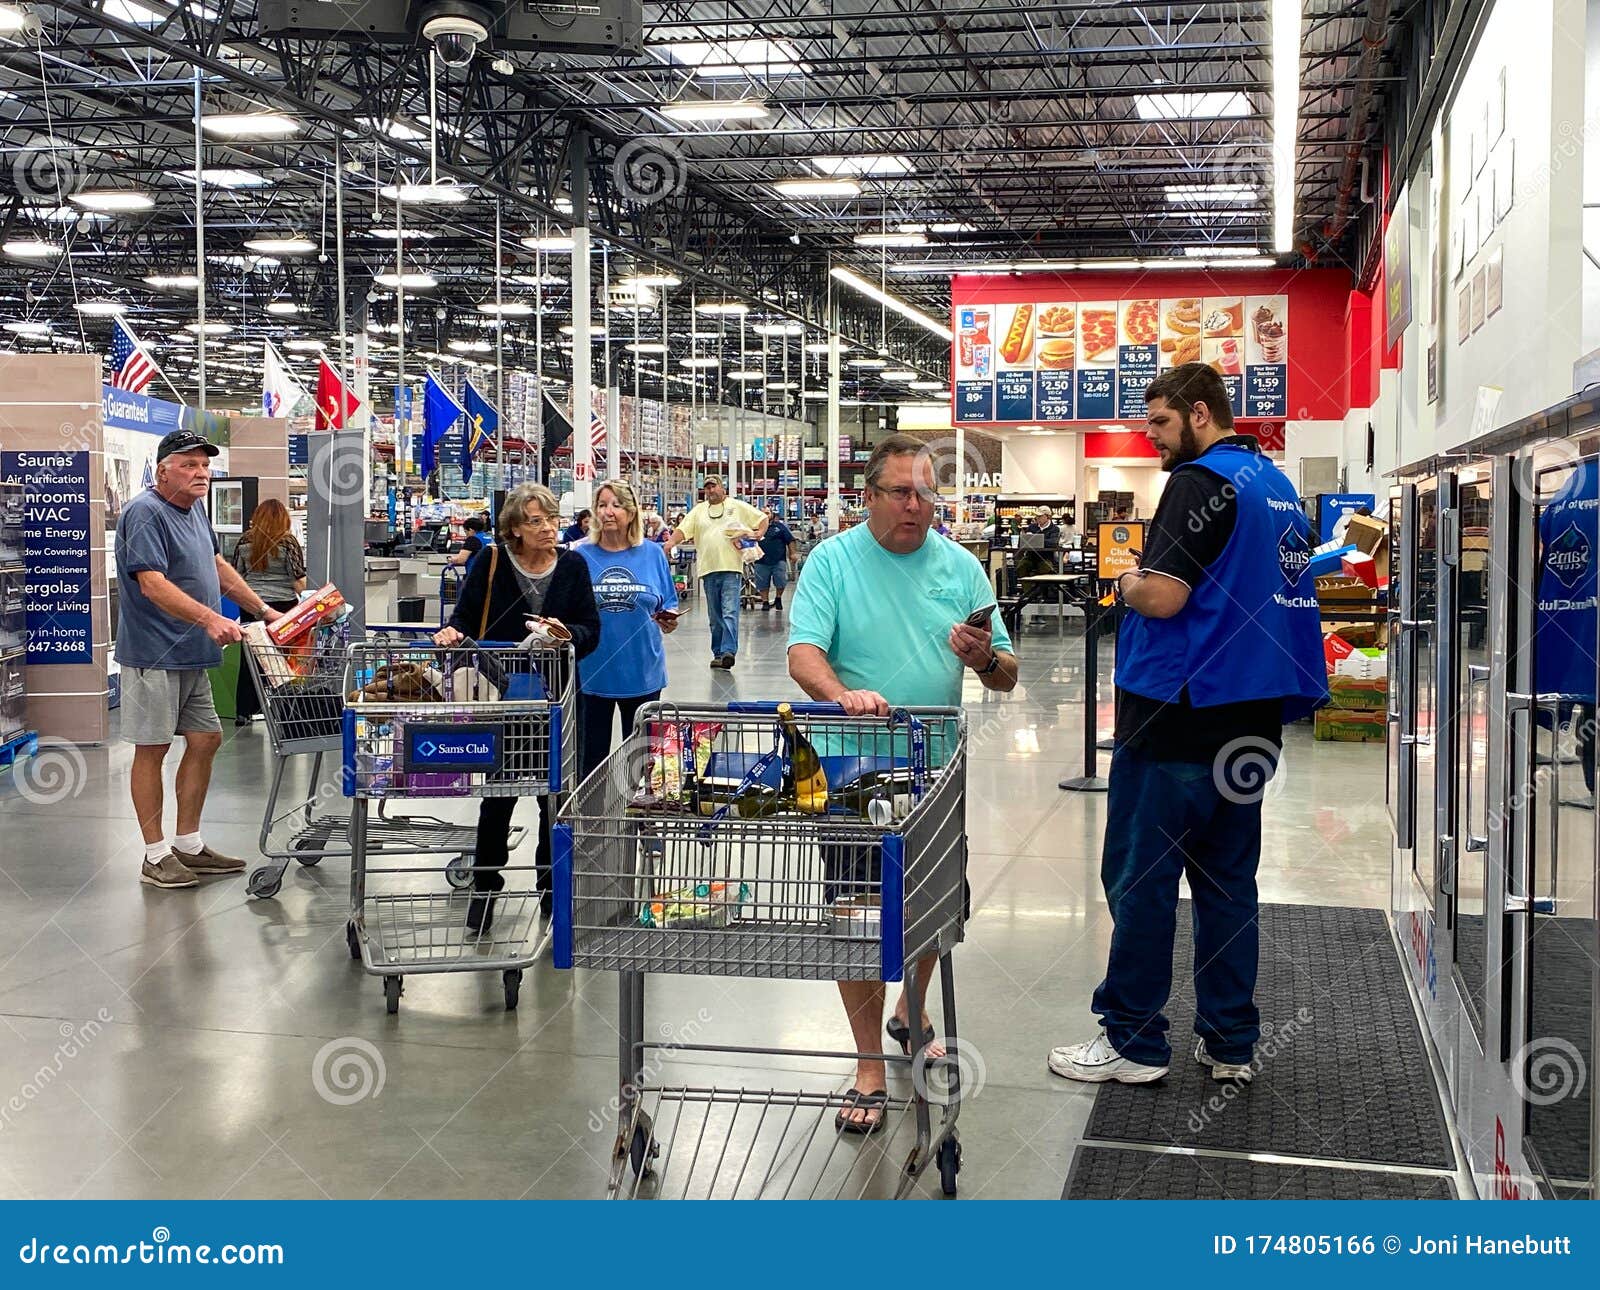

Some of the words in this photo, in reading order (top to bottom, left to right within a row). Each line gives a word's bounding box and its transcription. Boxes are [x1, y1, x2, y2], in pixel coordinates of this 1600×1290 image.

[1124, 352, 1152, 363] $8.99
[1042, 381, 1069, 391] $2.50
[1083, 383, 1110, 393] $2.49
[1122, 377, 1154, 388] $13.99
[1253, 378, 1279, 388] $1.59
[1002, 384, 1028, 395] $1.50
[966, 392, 984, 403] 89¢
[108, 393, 149, 424] Guaranteed
[1041, 406, 1068, 416] $2.99
[1257, 402, 1275, 411] 99¢
[18, 453, 73, 467] Saunas
[7, 474, 22, 484] Air
[25, 474, 85, 484] Purification
[963, 472, 1001, 488] HAR
[25, 493, 85, 503] nrooms
[45, 527, 86, 540] Energy
[25, 548, 42, 556] dow
[44, 547, 87, 558] Coverings
[1110, 547, 1131, 556] Club
[1105, 557, 1137, 566] Pickup
[34, 566, 88, 574] Conditioners
[25, 580, 80, 597] ergolas
[593, 584, 608, 592] AKE
[610, 584, 647, 592] OCONEE
[27, 601, 54, 611] door
[57, 601, 89, 613] Living
[38, 626, 86, 637] in-home
[28, 641, 85, 652] 647-3668
[438, 744, 464, 754] Sam's
[466, 743, 489, 754] Club
